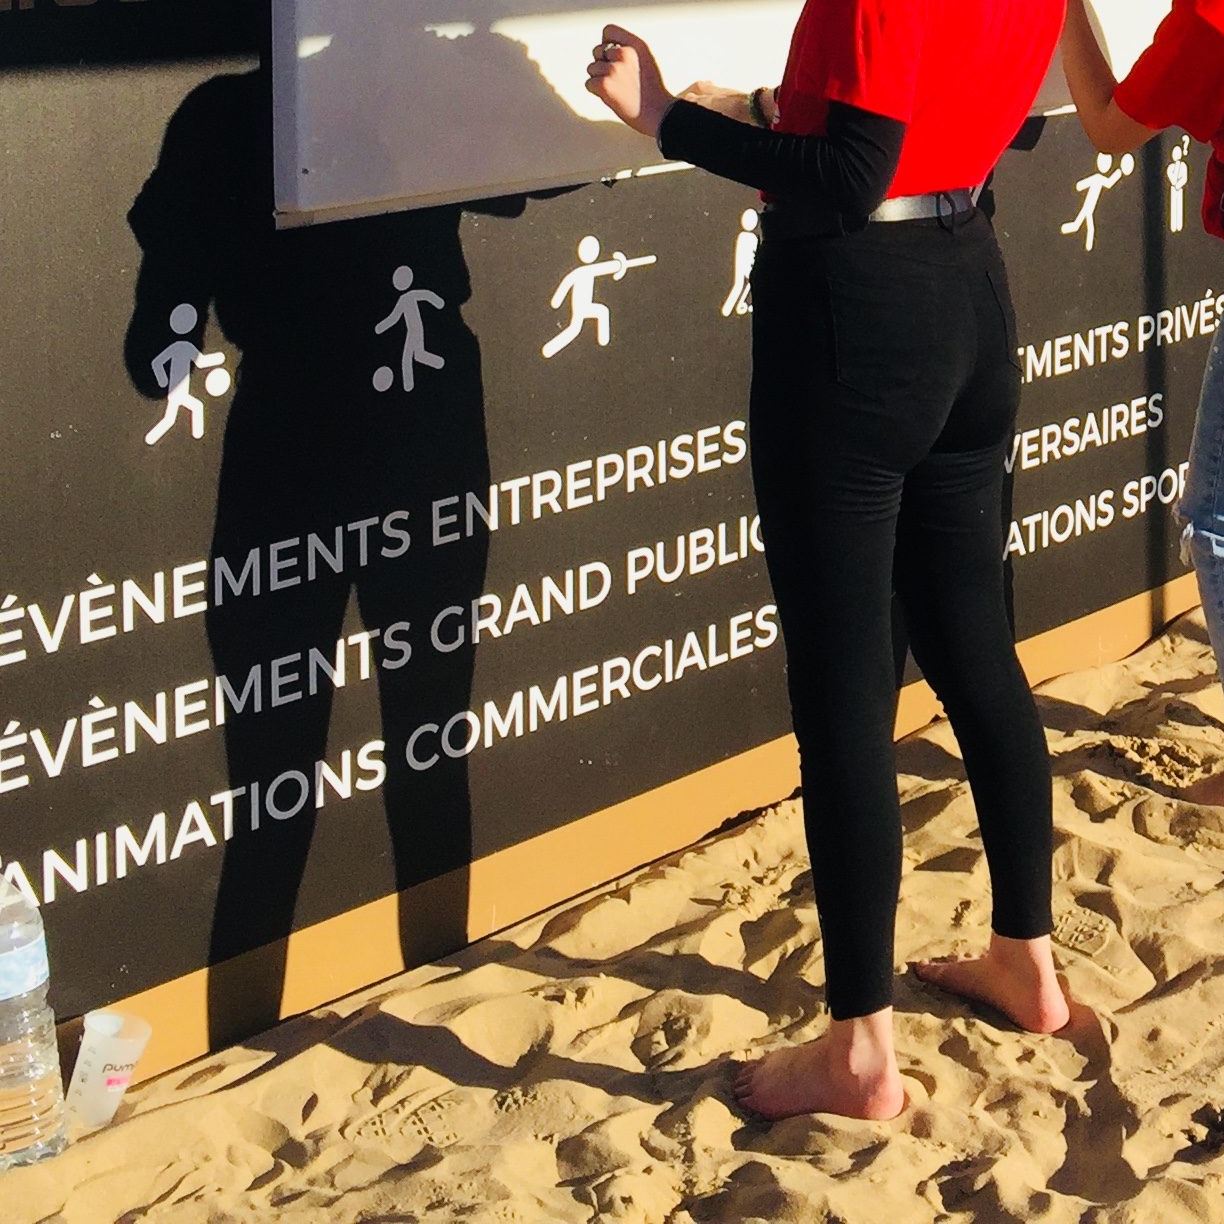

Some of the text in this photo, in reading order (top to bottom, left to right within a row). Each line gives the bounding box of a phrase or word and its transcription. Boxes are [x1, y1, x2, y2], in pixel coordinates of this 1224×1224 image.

[0, 419, 747, 665] ÉVÈNEMENTS ENTREPRISES
[1002, 489, 1115, 562] ATIONS
[0, 621, 412, 792] ÉVÈNEMENTS
[430, 561, 612, 654] GRAND
[405, 605, 779, 771] COMMERCIALES
